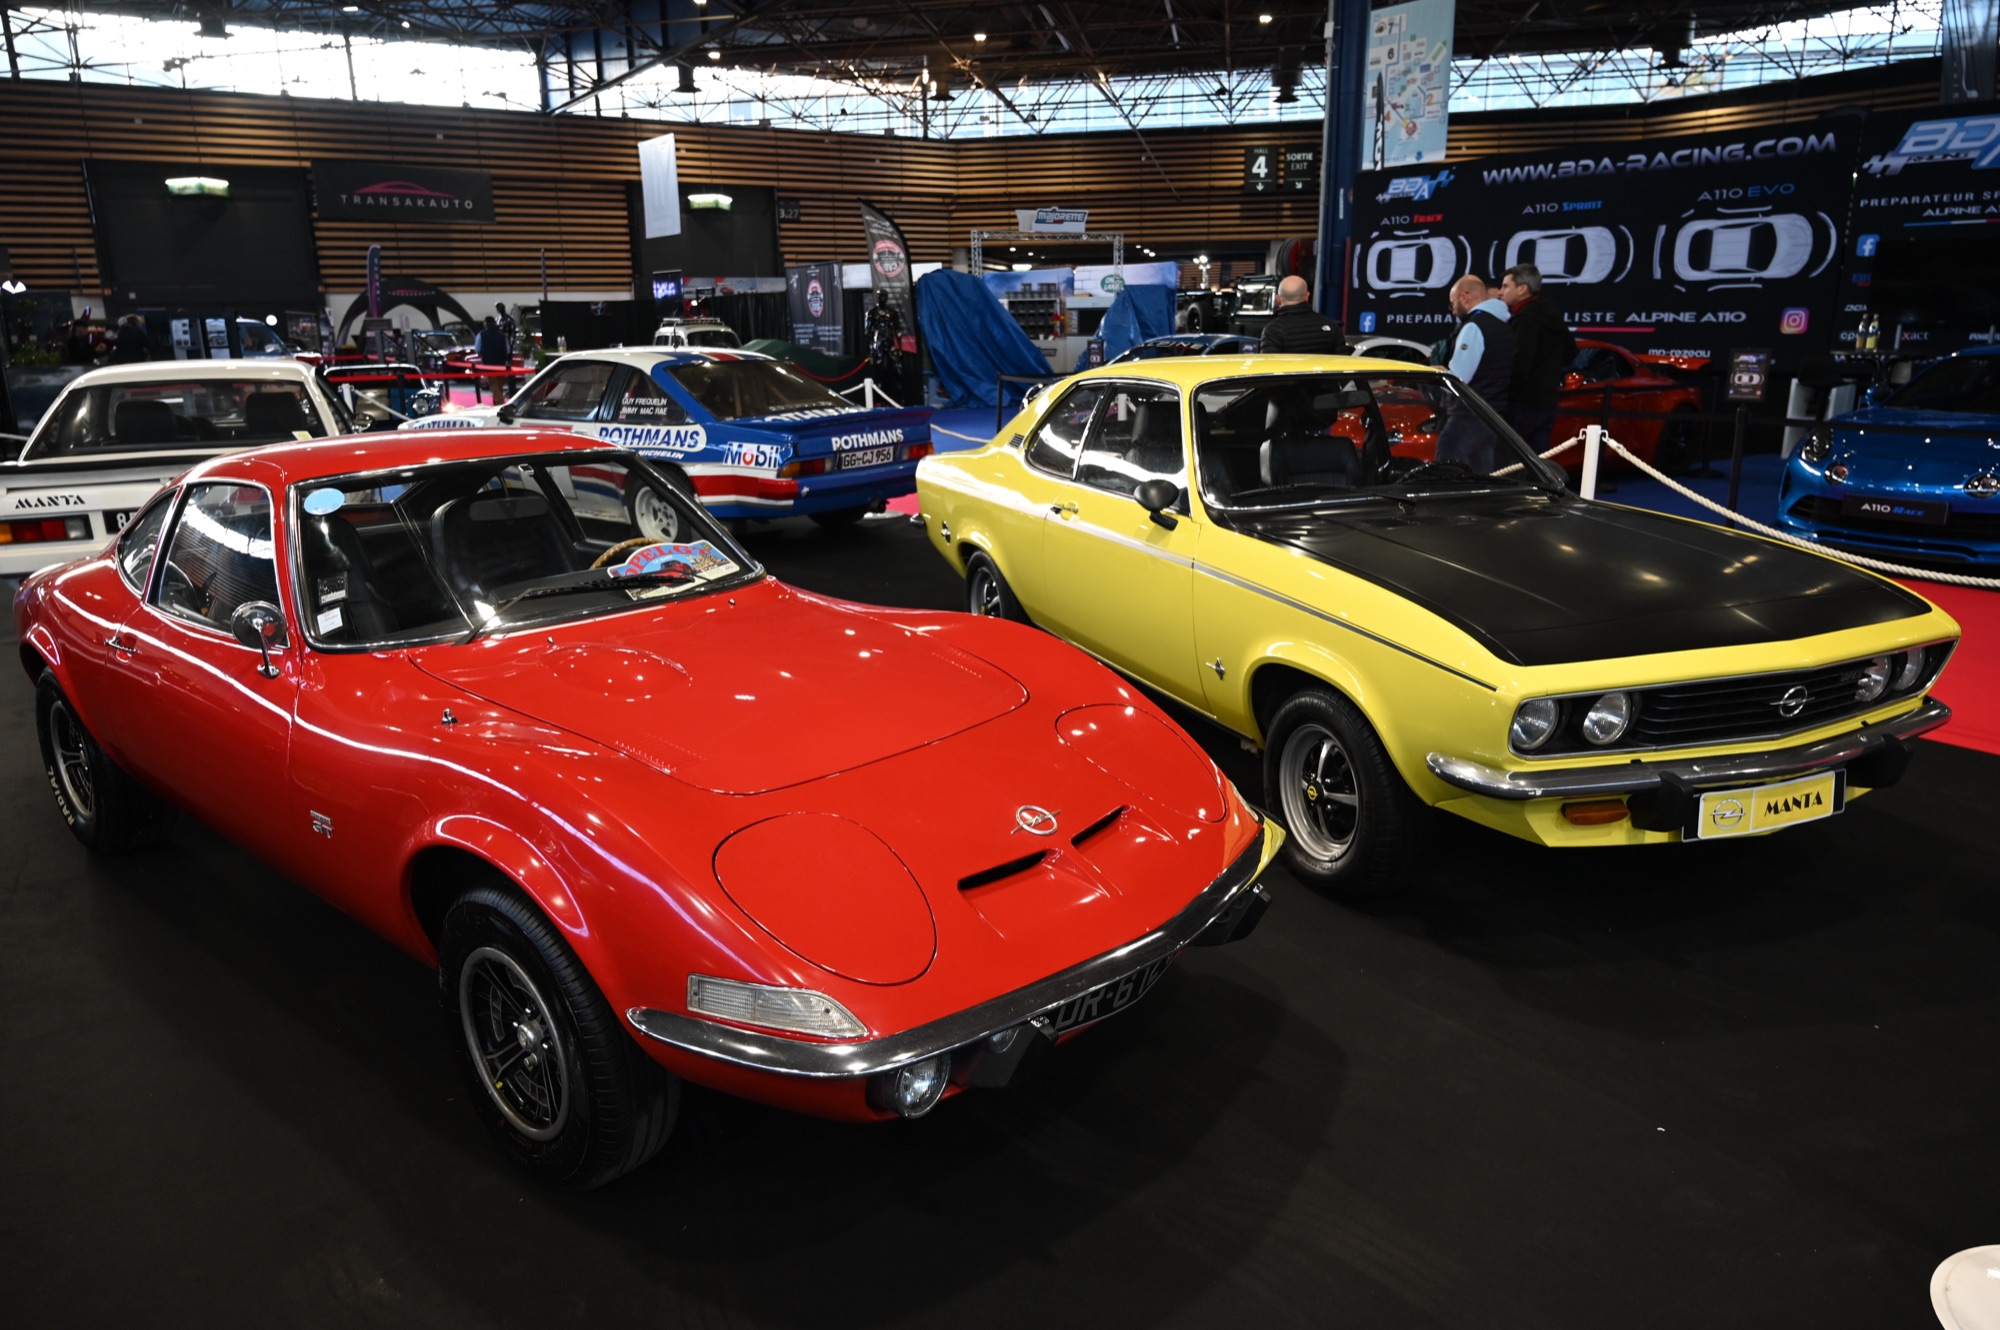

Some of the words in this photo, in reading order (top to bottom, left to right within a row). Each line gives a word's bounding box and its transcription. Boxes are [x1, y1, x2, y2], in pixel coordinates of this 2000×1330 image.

[1286, 152, 1313, 161] SORTIE
[1483, 132, 1837, 187] WWW.BDA-RACING.COM
[1251, 155, 1268, 178] 4
[1290, 162, 1308, 171] EXIT
[1697, 188, 1743, 202] A110
[1747, 183, 1795, 198] EVO
[1860, 192, 1975, 208] PREPARATEUR
[340, 194, 473, 209] TRANSAKAUTO
[1522, 202, 1558, 215] A110
[779, 208, 799, 219] 3.27
[1922, 206, 1982, 217] ALPINE
[1380, 215, 1410, 226] A110
[1625, 311, 1697, 323] ALPINE
[1700, 311, 1747, 323] A110
[621, 397, 634, 406] GUY
[619, 406, 638, 416] JIMMY
[639, 406, 654, 416] MAC
[654, 406, 668, 416] RAE
[598, 426, 700, 449] ROTHMANS
[831, 428, 904, 452] ROTHMANS
[637, 449, 685, 460] MICHELIN
[724, 442, 780, 469] Mobil
[875, 449, 892, 464] 956
[15, 494, 86, 509] MANTA
[1861, 503, 1891, 513] A110
[47, 765, 75, 826] RADIAL
[1764, 790, 1823, 817] MANTA
